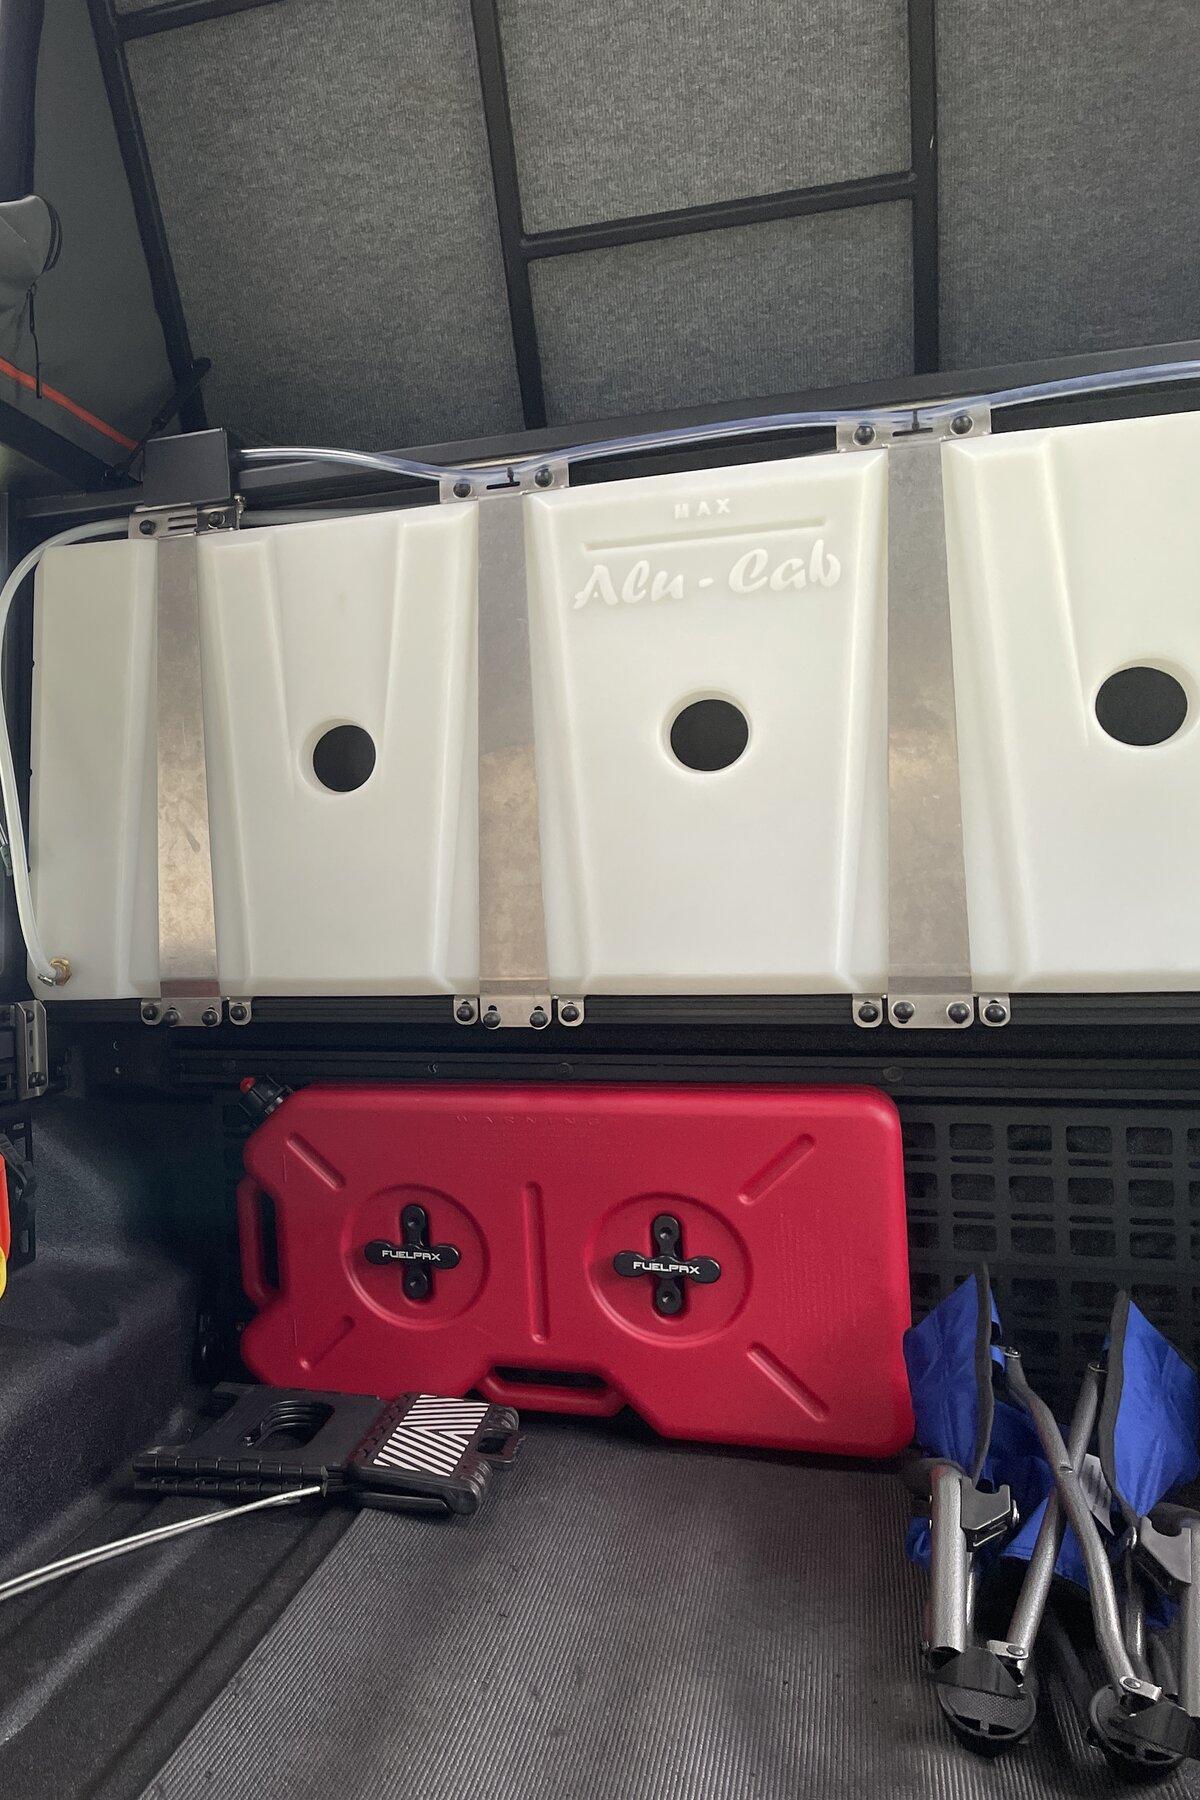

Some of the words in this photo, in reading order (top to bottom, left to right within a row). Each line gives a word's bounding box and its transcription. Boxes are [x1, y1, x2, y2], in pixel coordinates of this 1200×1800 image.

[673, 498, 731, 519] MAX
[381, 1249, 441, 1262] FUELPAX
[632, 1260, 700, 1275] FUELPAX
